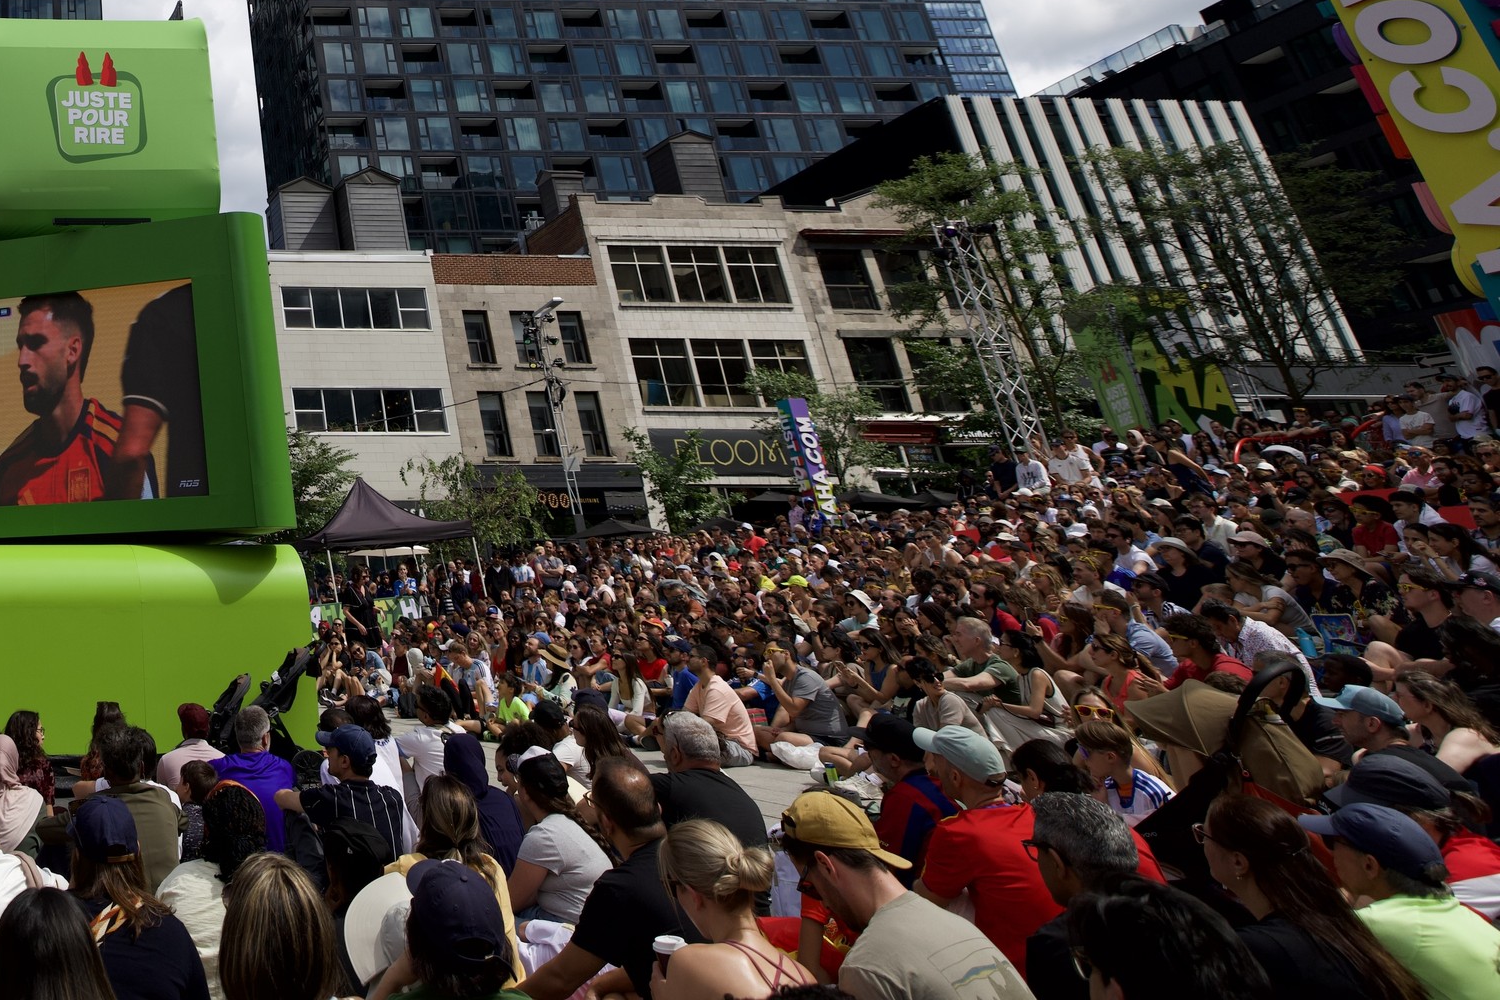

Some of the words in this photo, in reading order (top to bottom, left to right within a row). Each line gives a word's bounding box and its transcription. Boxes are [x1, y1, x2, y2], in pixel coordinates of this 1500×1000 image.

[61, 90, 132, 109] JUSTE
[68, 108, 129, 127] POUR
[74, 127, 125, 145] RIRE
[179, 480, 200, 488] RDS
